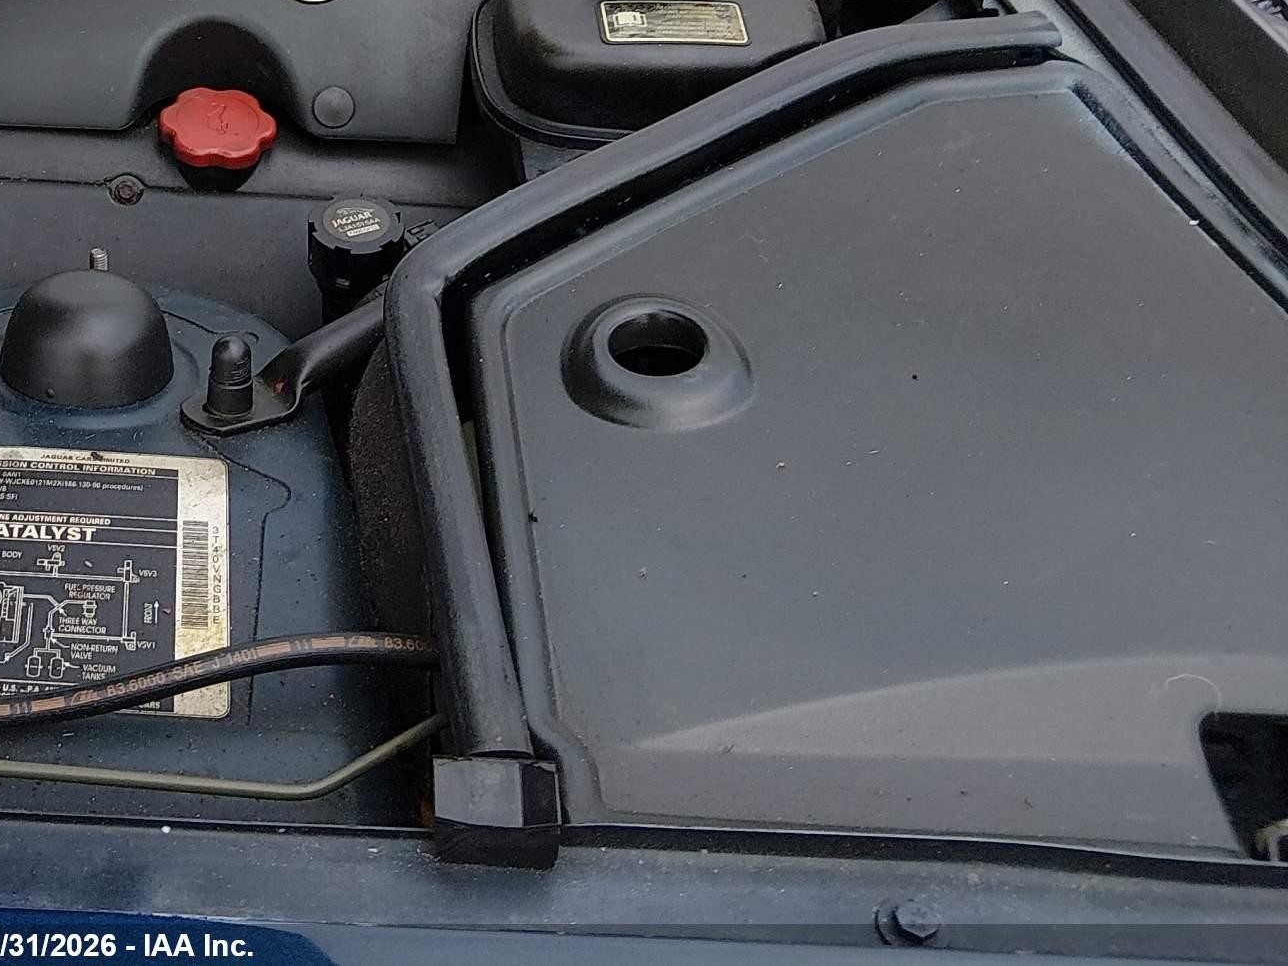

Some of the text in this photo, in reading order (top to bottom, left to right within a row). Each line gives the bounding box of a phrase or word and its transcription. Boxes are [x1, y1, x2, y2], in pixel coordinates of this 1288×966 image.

[331, 211, 373, 228] JAGUAR
[99, 456, 130, 464] IMITED
[30, 462, 81, 472] CONTROL
[83, 464, 156, 476] INFORMATION
[12, 514, 68, 523] ADJUSTMENT
[69, 516, 111, 525] REQUIRED
[2, 550, 22, 558] BODY
[64, 583, 116, 593] FUEL PRESSURE
[69, 591, 111, 600] REGULATOR
[58, 616, 98, 626] THREE WAY
[58, 625, 107, 635] CONNECTOR
[70, 643, 119, 654] NON-RETURN
[70, 651, 93, 660] VALVE
[82, 664, 117, 673] VACUUM
[81, 672, 106, 680] TANKS
[106, 672, 167, 696] 83.6000
[172, 661, 201, 681] SAE
[212, 656, 220, 669] J
[2, 684, 18, 693] U.S.
